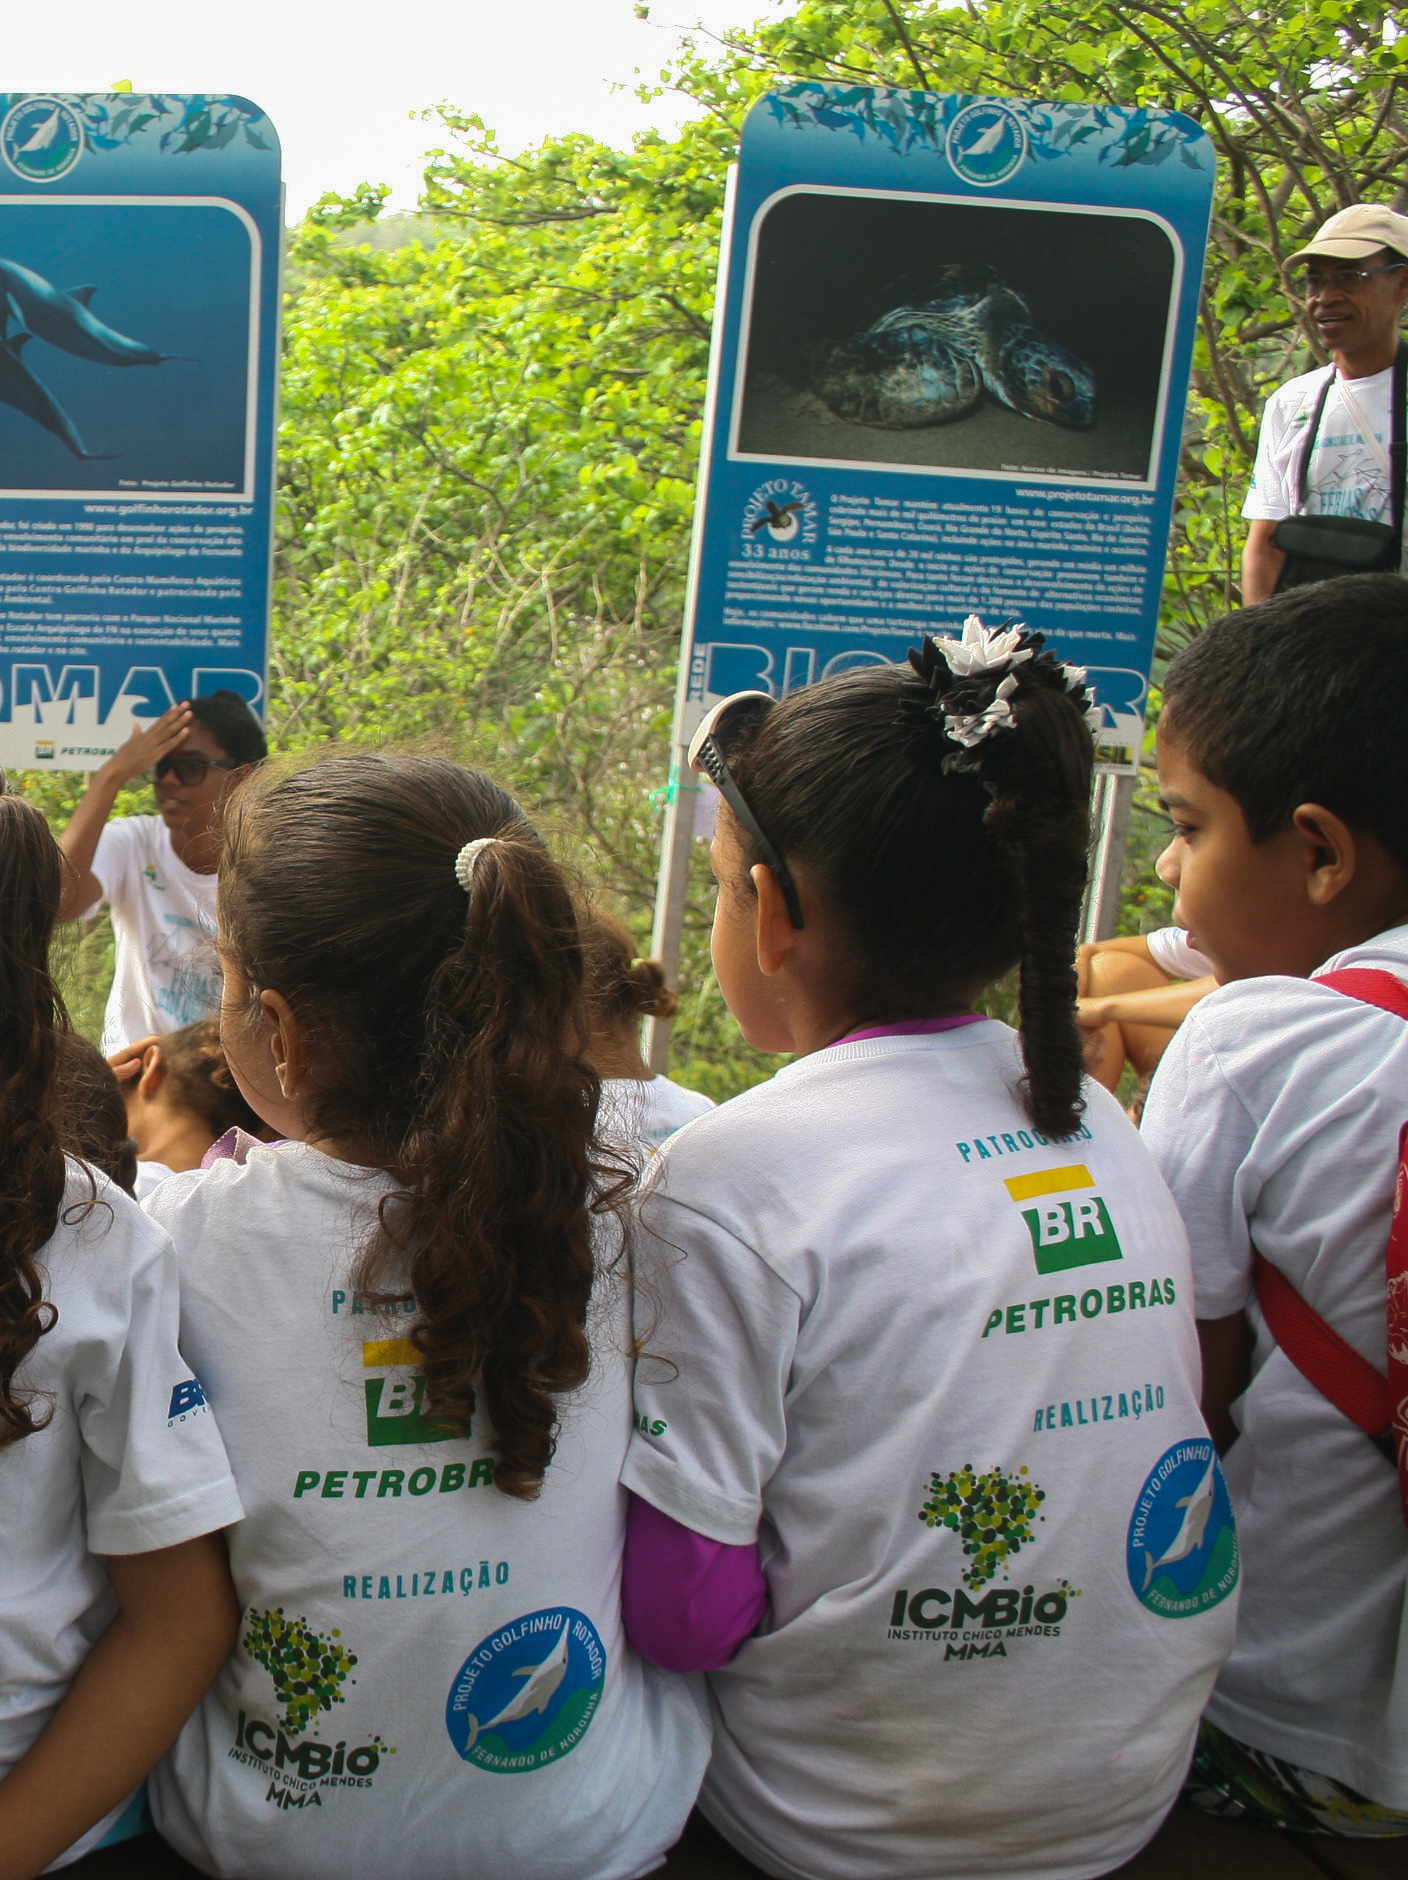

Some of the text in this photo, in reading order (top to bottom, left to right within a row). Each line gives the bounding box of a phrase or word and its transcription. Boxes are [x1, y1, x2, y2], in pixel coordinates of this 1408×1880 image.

[84, 503, 254, 517] www.golfinhorotador.org.br
[741, 478, 818, 543] PROJETO TAMAR
[1015, 488, 1154, 506] www.projetotamar.org.br
[741, 543, 811, 560] 33 anos
[1039, 1199, 1105, 1247] BR
[981, 1277, 1177, 1338] PETROBRAS
[1033, 1384, 1165, 1432] REALIZAÇÃO
[293, 1458, 496, 1498] PETROBR
[1133, 1445, 1211, 1548] PROJETO GOLFINHO
[343, 1561, 510, 1599] REALIZAÇÃO
[1148, 1589, 1199, 1612] FERNANDO
[1202, 1589, 1217, 1604] DE
[890, 1585, 1068, 1629] ICMBio
[887, 1626, 1061, 1641] INSTITUTO CHICO MENDES
[944, 1641, 1008, 1661] MMA
[453, 1614, 603, 1712] PROJETO GOLFINHO ROTADOR
[235, 1709, 380, 1780] ICMBio
[471, 1692, 599, 1769] FERNANDO DE NORONHA
[228, 1747, 373, 1792] INSTITUTO CHICO MENDES
[265, 1781, 322, 1810] MMA
